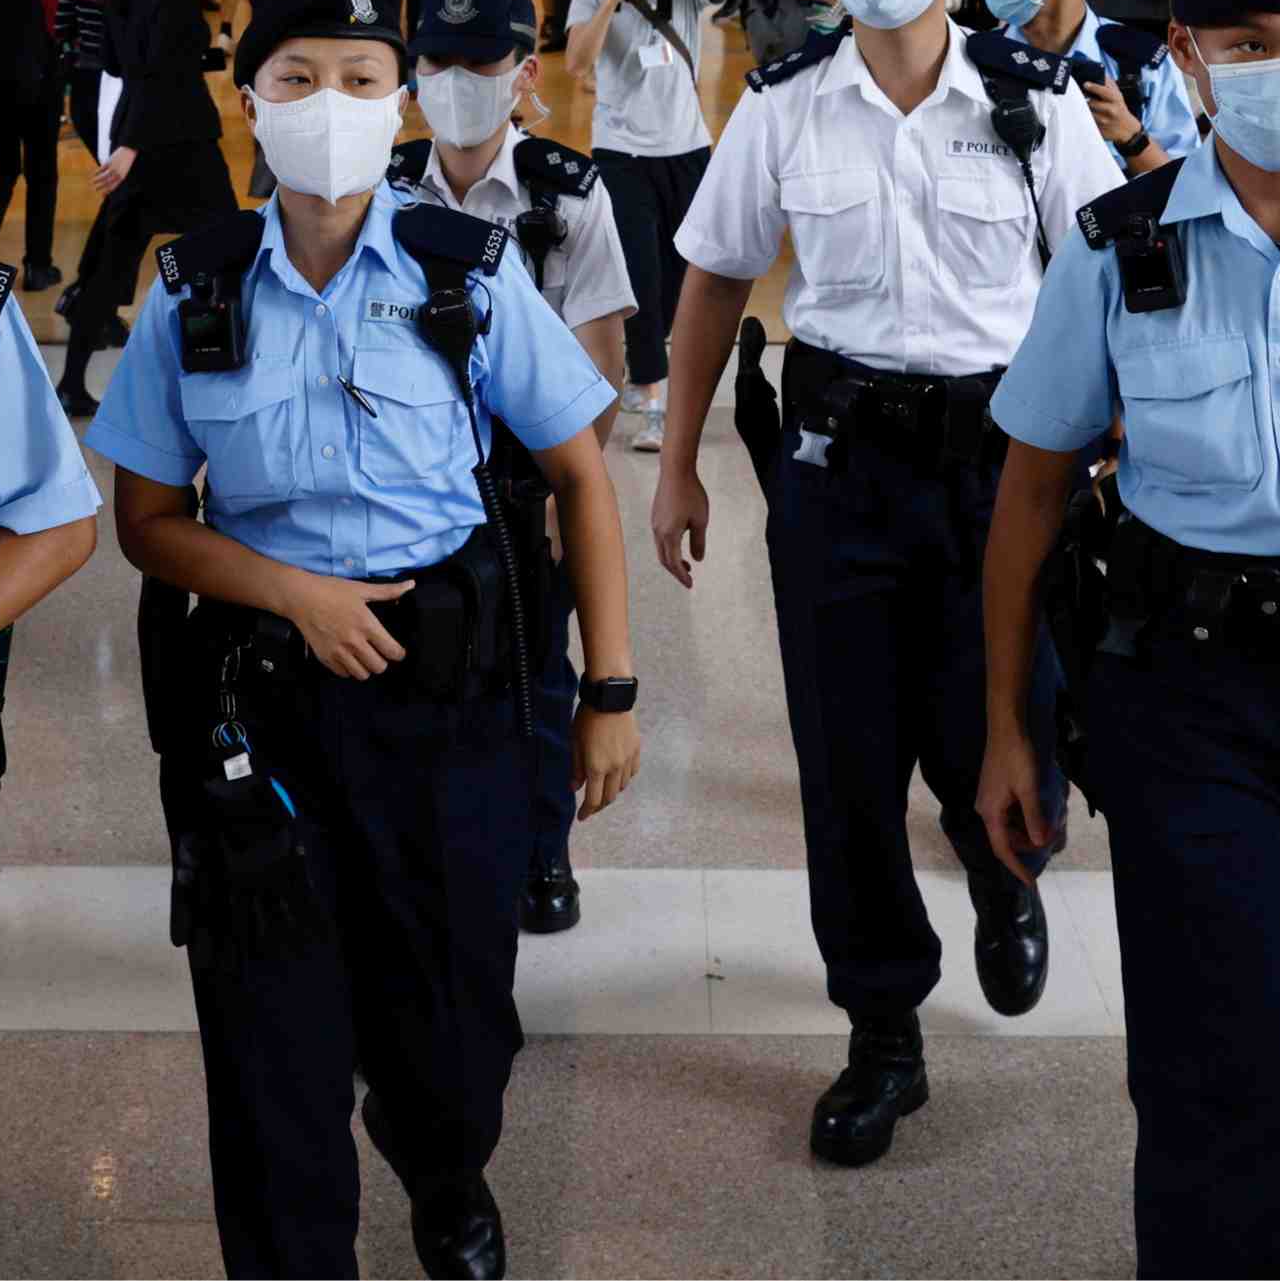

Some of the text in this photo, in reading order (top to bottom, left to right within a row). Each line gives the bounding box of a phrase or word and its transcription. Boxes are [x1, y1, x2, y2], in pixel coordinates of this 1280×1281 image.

[482, 228, 505, 265] 26532
[159, 247, 180, 283] 26532
[369, 301, 387, 318] 警
